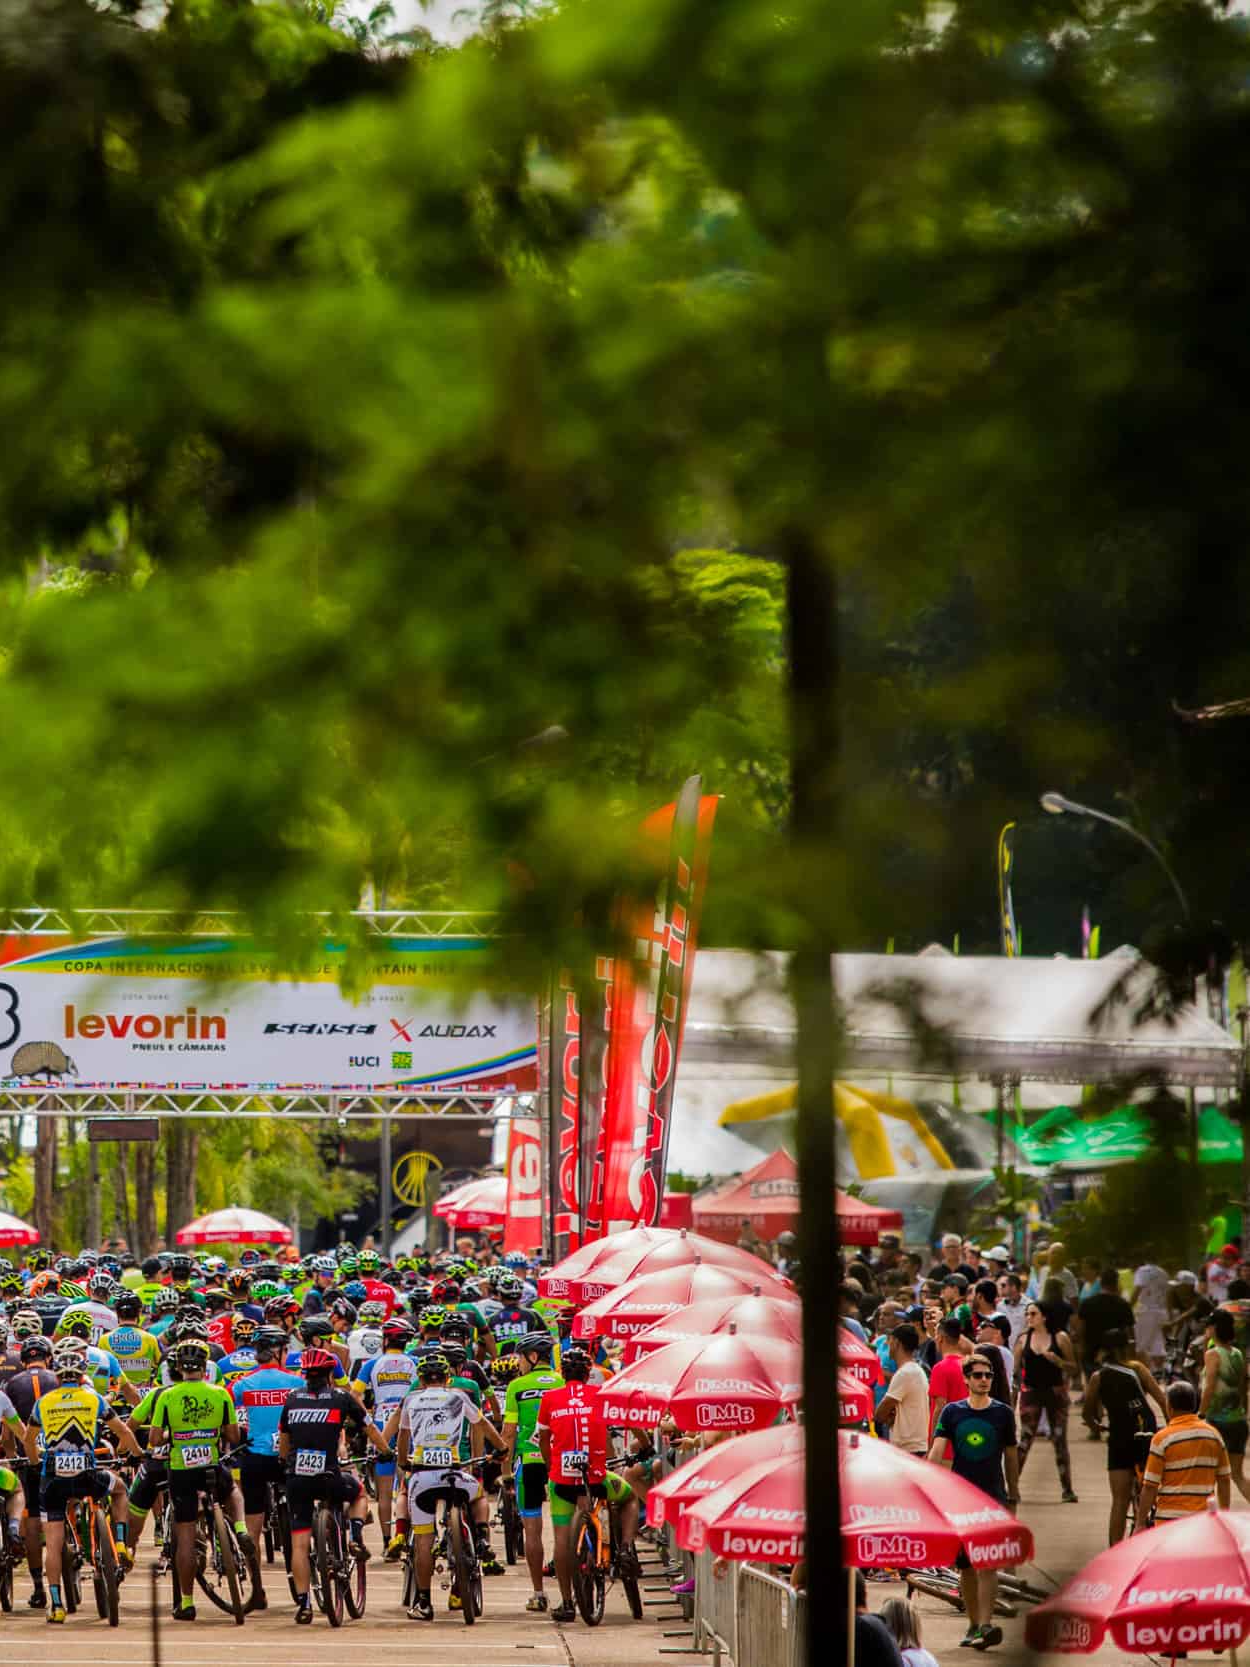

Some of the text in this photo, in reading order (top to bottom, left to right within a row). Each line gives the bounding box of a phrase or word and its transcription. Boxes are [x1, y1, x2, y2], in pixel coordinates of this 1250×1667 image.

[63, 960, 103, 973] COPA
[64, 1004, 227, 1040] levorin
[419, 1024, 497, 1037] AUDAX
[132, 1043, 165, 1052] PNEUS
[354, 1056, 380, 1067] UCI
[252, 1391, 287, 1405] TREK
[603, 1401, 662, 1422] levorin
[57, 1456, 83, 1470] 2412
[298, 1456, 324, 1469] 2423
[425, 1451, 451, 1465] 2419
[723, 1531, 805, 1557] levori
[968, 1536, 1021, 1564] levorin
[1127, 1583, 1245, 1605] levorin
[1126, 1618, 1242, 1646] levorin
